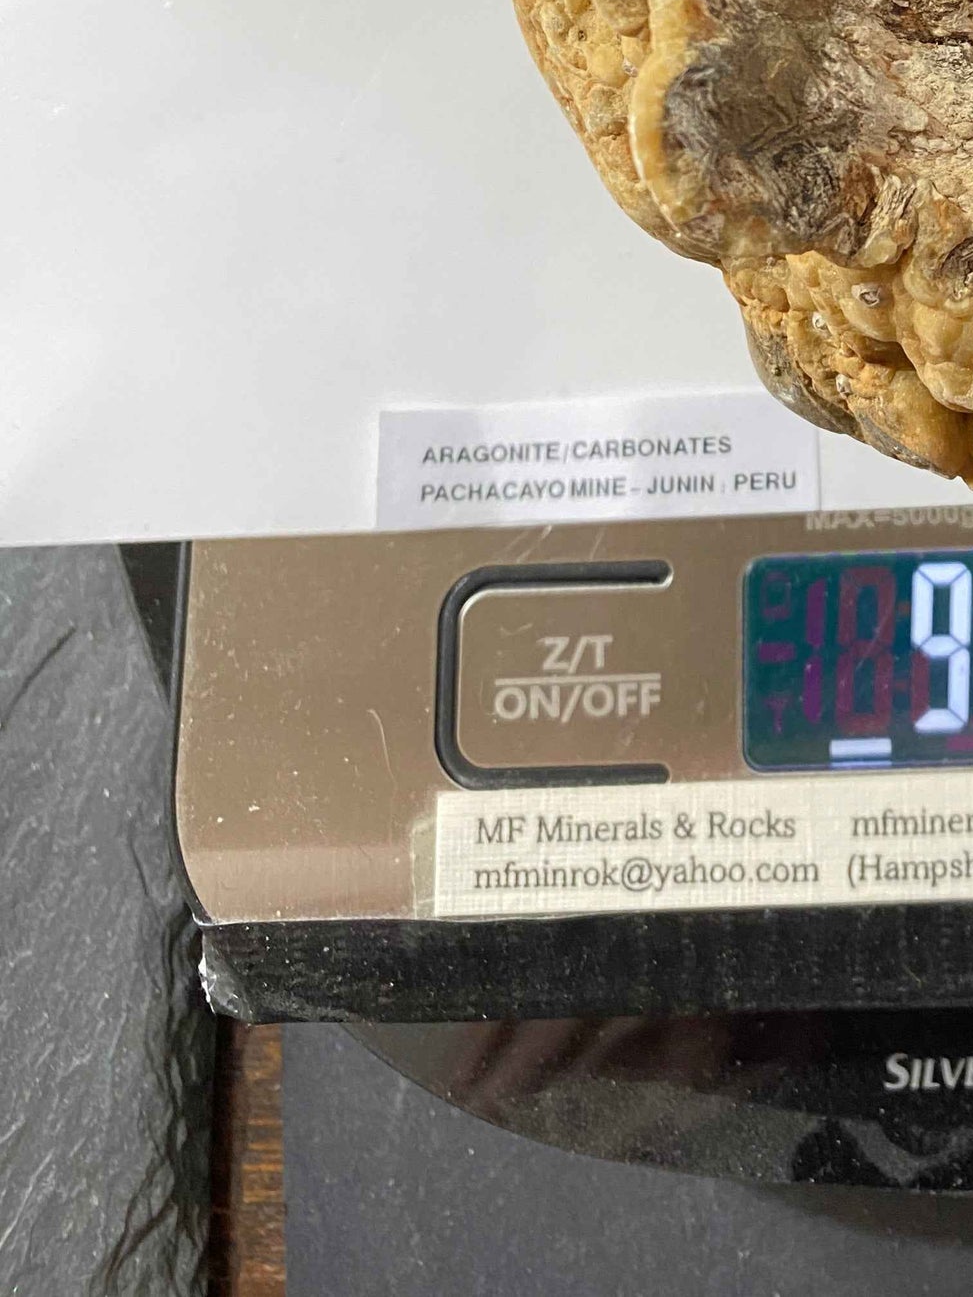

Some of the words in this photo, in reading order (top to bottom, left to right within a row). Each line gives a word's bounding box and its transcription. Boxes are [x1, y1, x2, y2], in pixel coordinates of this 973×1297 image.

[421, 435, 733, 465] ARAGONITE/CARBONATES
[419, 479, 566, 503] PACHACAYO
[570, 477, 627, 498] MINE
[646, 474, 715, 496] JUNIN
[733, 471, 798, 493] PERU
[541, 634, 614, 674] Z/T
[494, 681, 662, 723] ON/OFF
[476, 815, 526, 844] MF
[536, 812, 663, 843] Minerals
[673, 812, 697, 839] &
[708, 808, 797, 840] Rocks
[473, 855, 821, 892] mfminrok@yahoo.com
